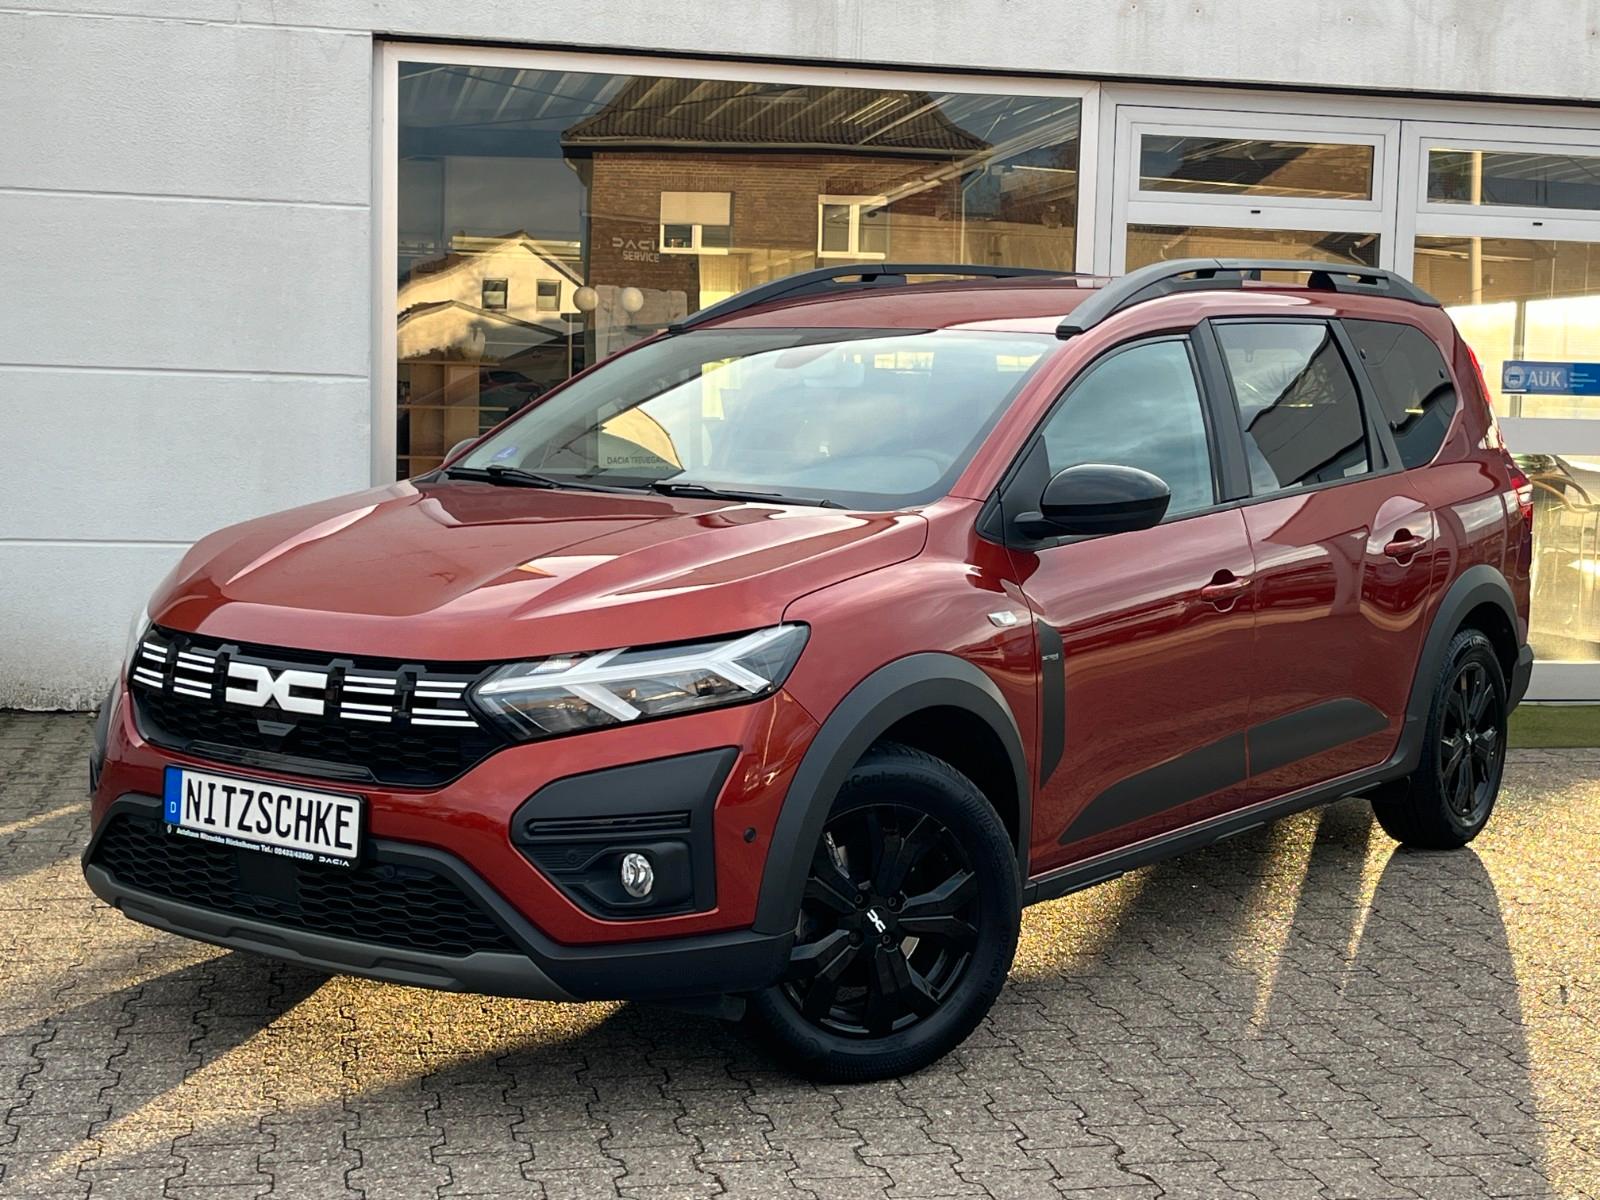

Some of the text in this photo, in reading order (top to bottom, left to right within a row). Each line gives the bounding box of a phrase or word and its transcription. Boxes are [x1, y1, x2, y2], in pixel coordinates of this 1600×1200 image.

[612, 237, 656, 251] DACI
[623, 250, 660, 263] SERVICE
[170, 801, 176, 813] D
[186, 777, 354, 850] NITZSCHKE
[318, 856, 350, 867] DACIA
